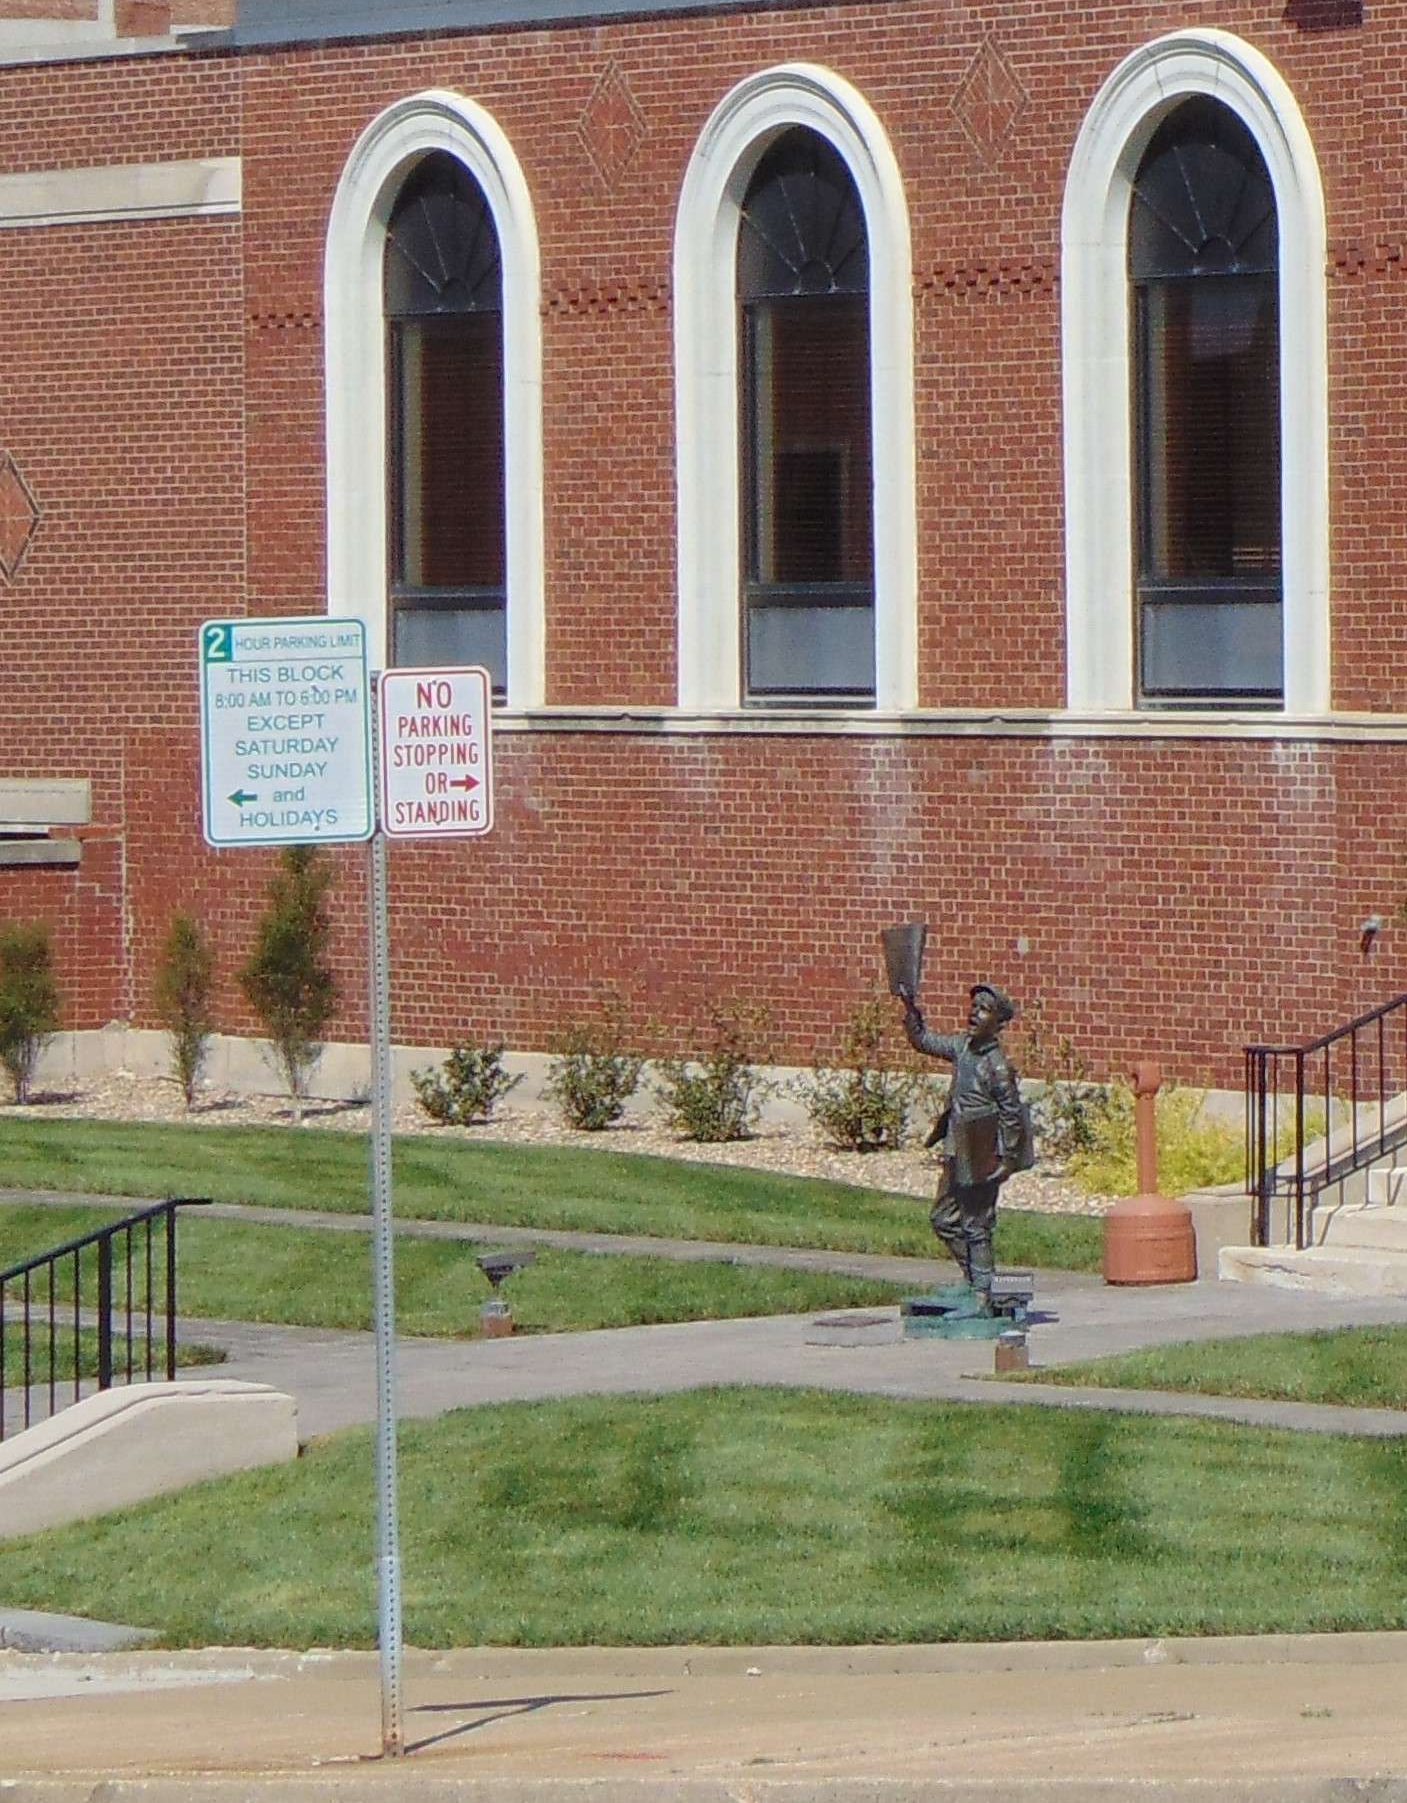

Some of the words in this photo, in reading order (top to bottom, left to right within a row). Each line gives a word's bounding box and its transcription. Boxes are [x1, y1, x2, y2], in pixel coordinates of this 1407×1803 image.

[207, 627, 226, 658] 2
[236, 636, 271, 651] HOUR
[274, 634, 327, 649] PARKING
[329, 633, 361, 648] LIMIT
[227, 667, 272, 684] THIS
[278, 665, 344, 683] BLOCK
[248, 691, 272, 707] AM
[275, 690, 296, 706] TO
[334, 688, 358, 704] PM
[416, 680, 453, 709] NO
[247, 713, 325, 732] EXCEPT
[398, 714, 473, 739] PARKING
[235, 737, 339, 756] SATURDAY
[394, 742, 479, 768] STOPPING
[247, 761, 328, 780] SUNDAY
[425, 771, 448, 796] OR
[273, 786, 305, 803] and
[239, 808, 338, 828] HOLIDAYS
[395, 799, 480, 826] STANDING
